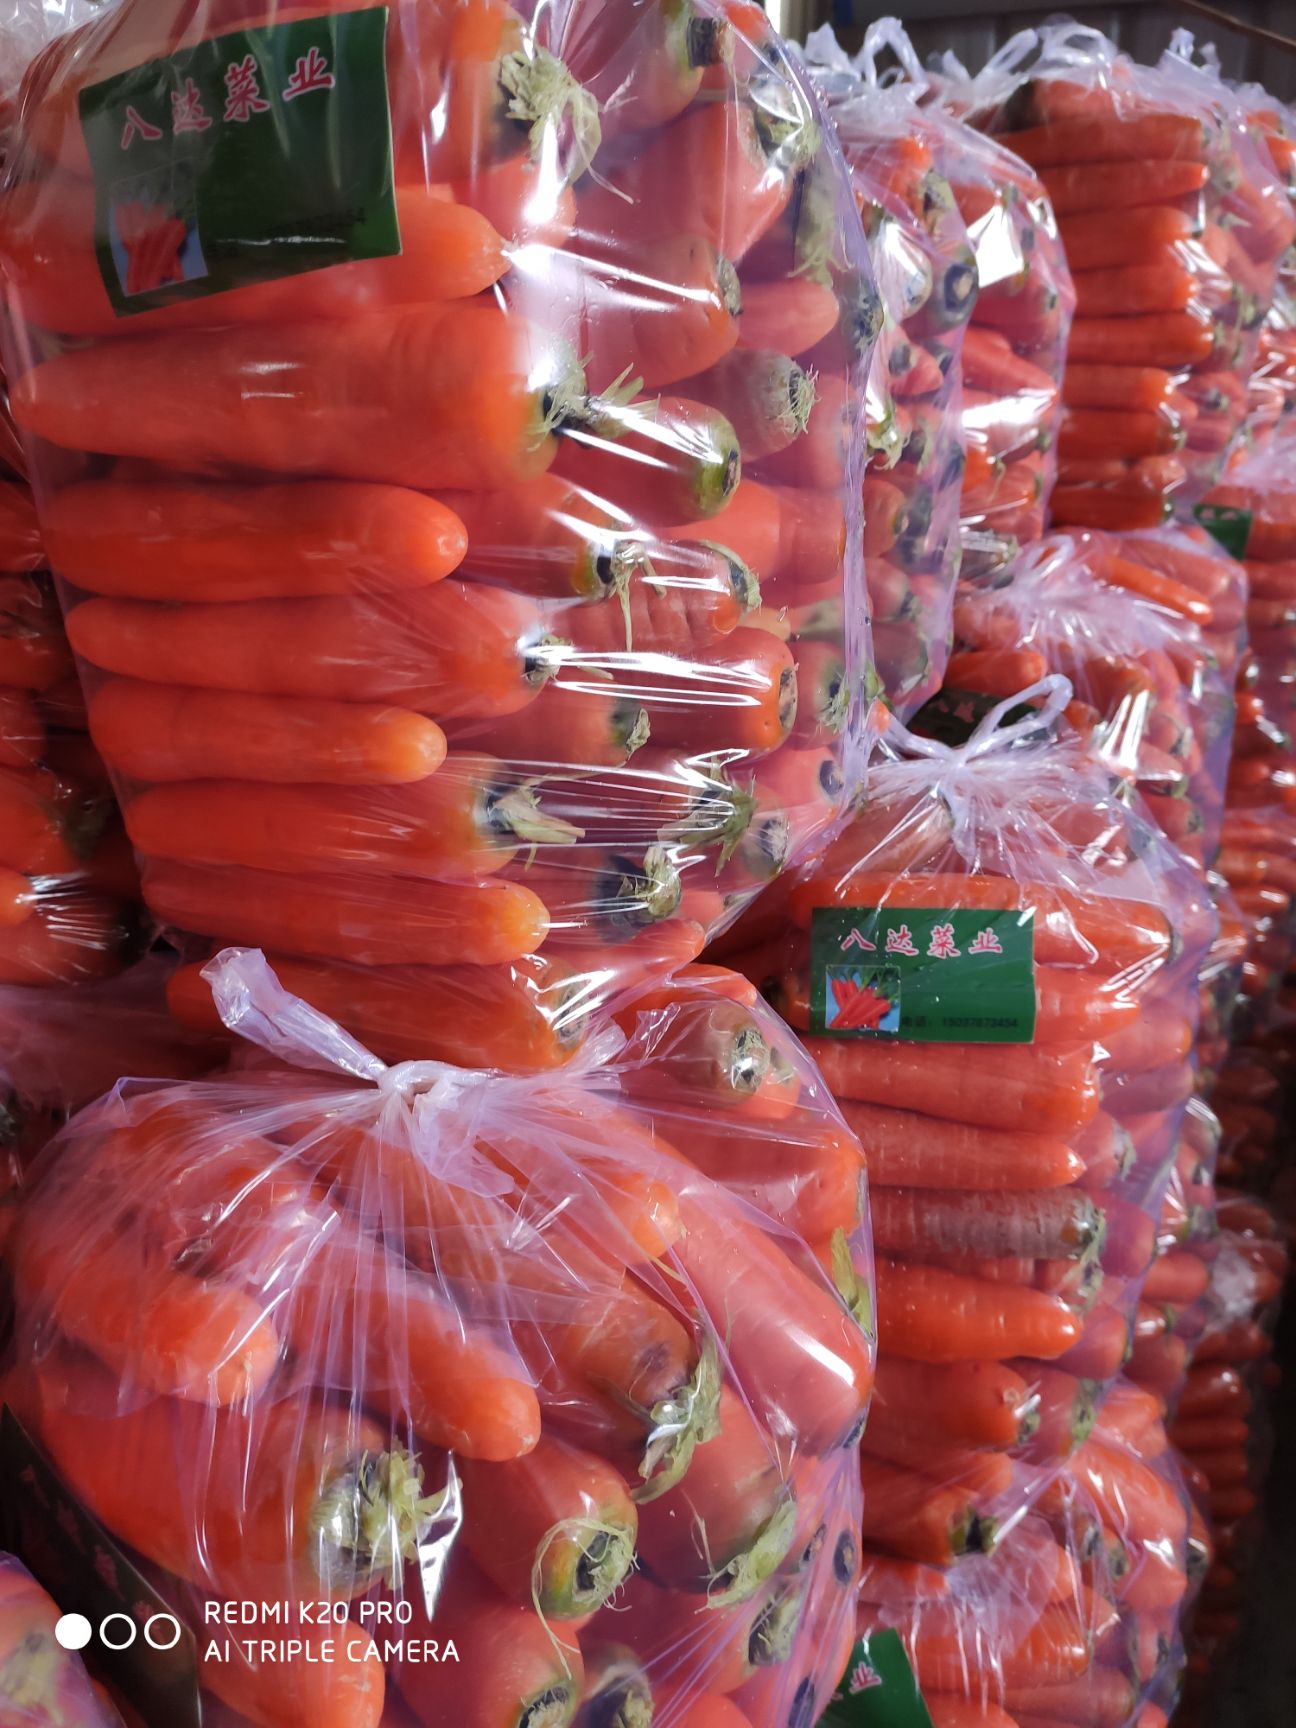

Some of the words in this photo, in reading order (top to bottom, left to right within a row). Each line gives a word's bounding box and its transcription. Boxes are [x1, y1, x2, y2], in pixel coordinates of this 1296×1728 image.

[120, 47, 336, 150] 八达菜业
[840, 922, 1004, 960] 八达菜业
